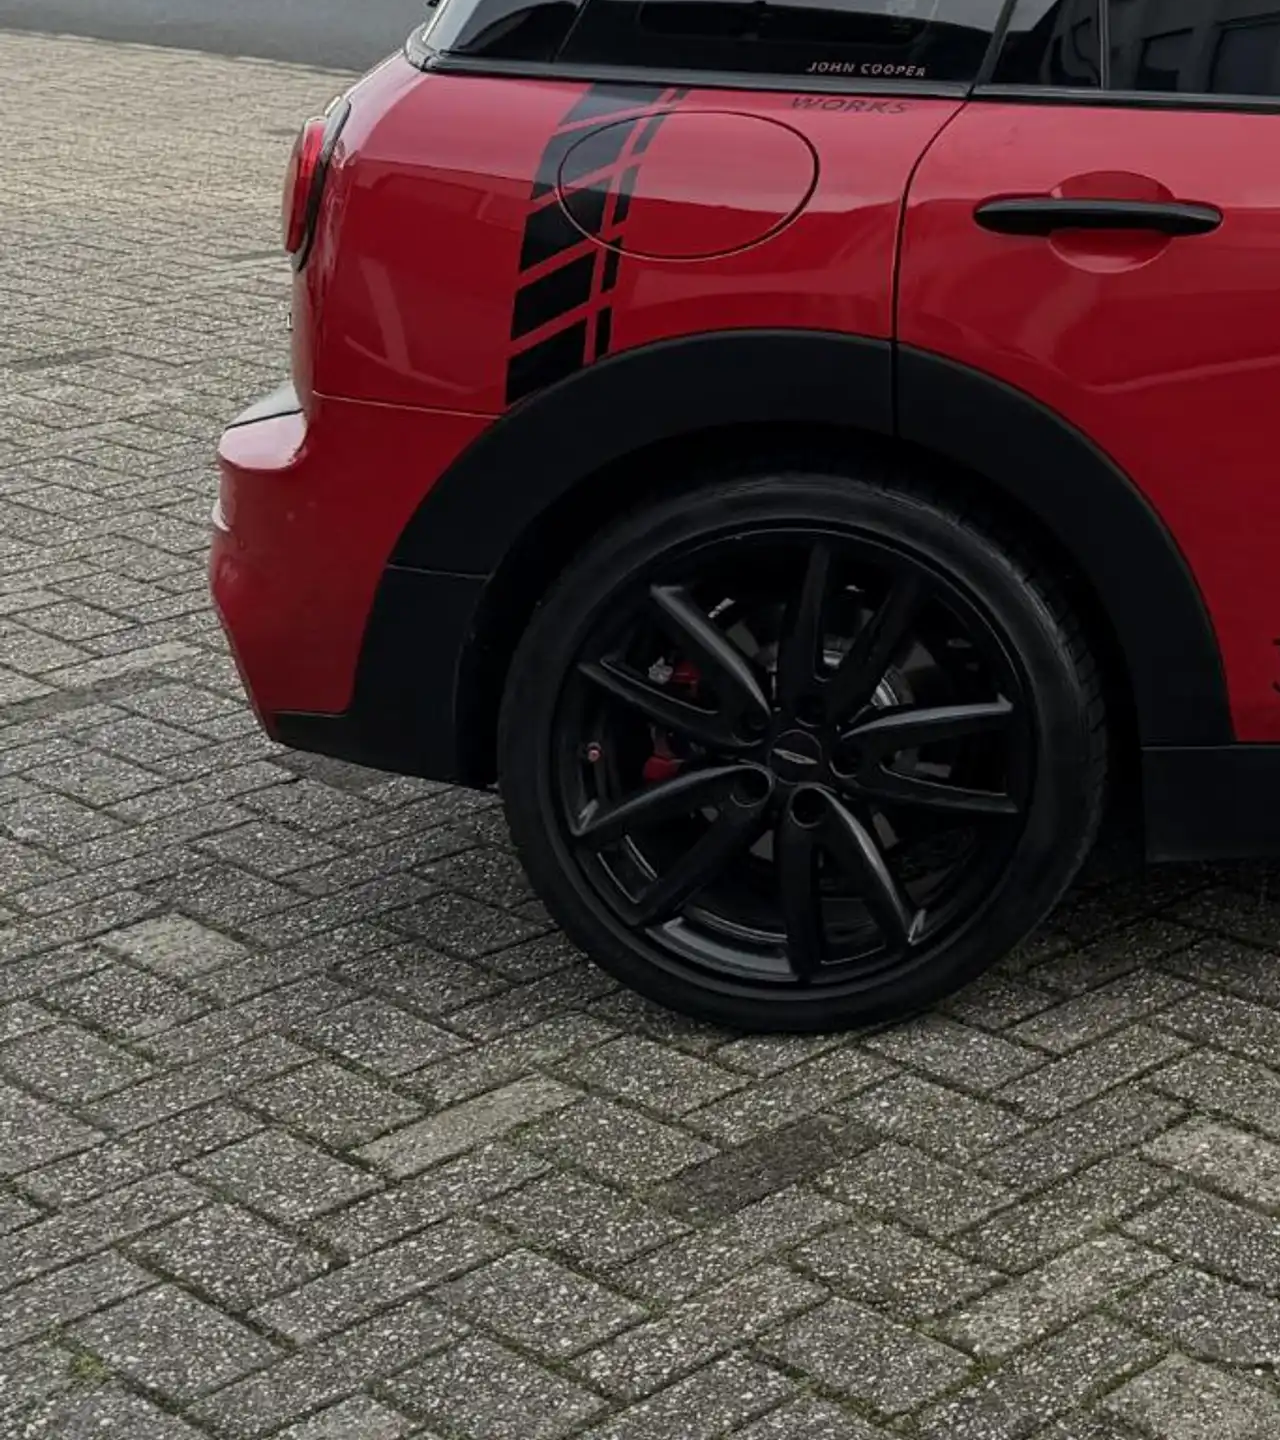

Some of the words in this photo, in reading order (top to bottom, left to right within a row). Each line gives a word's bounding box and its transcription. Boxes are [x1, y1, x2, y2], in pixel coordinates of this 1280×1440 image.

[805, 60, 855, 74] JOHN
[860, 62, 927, 77] COOPER
[792, 96, 912, 114] WORKS
